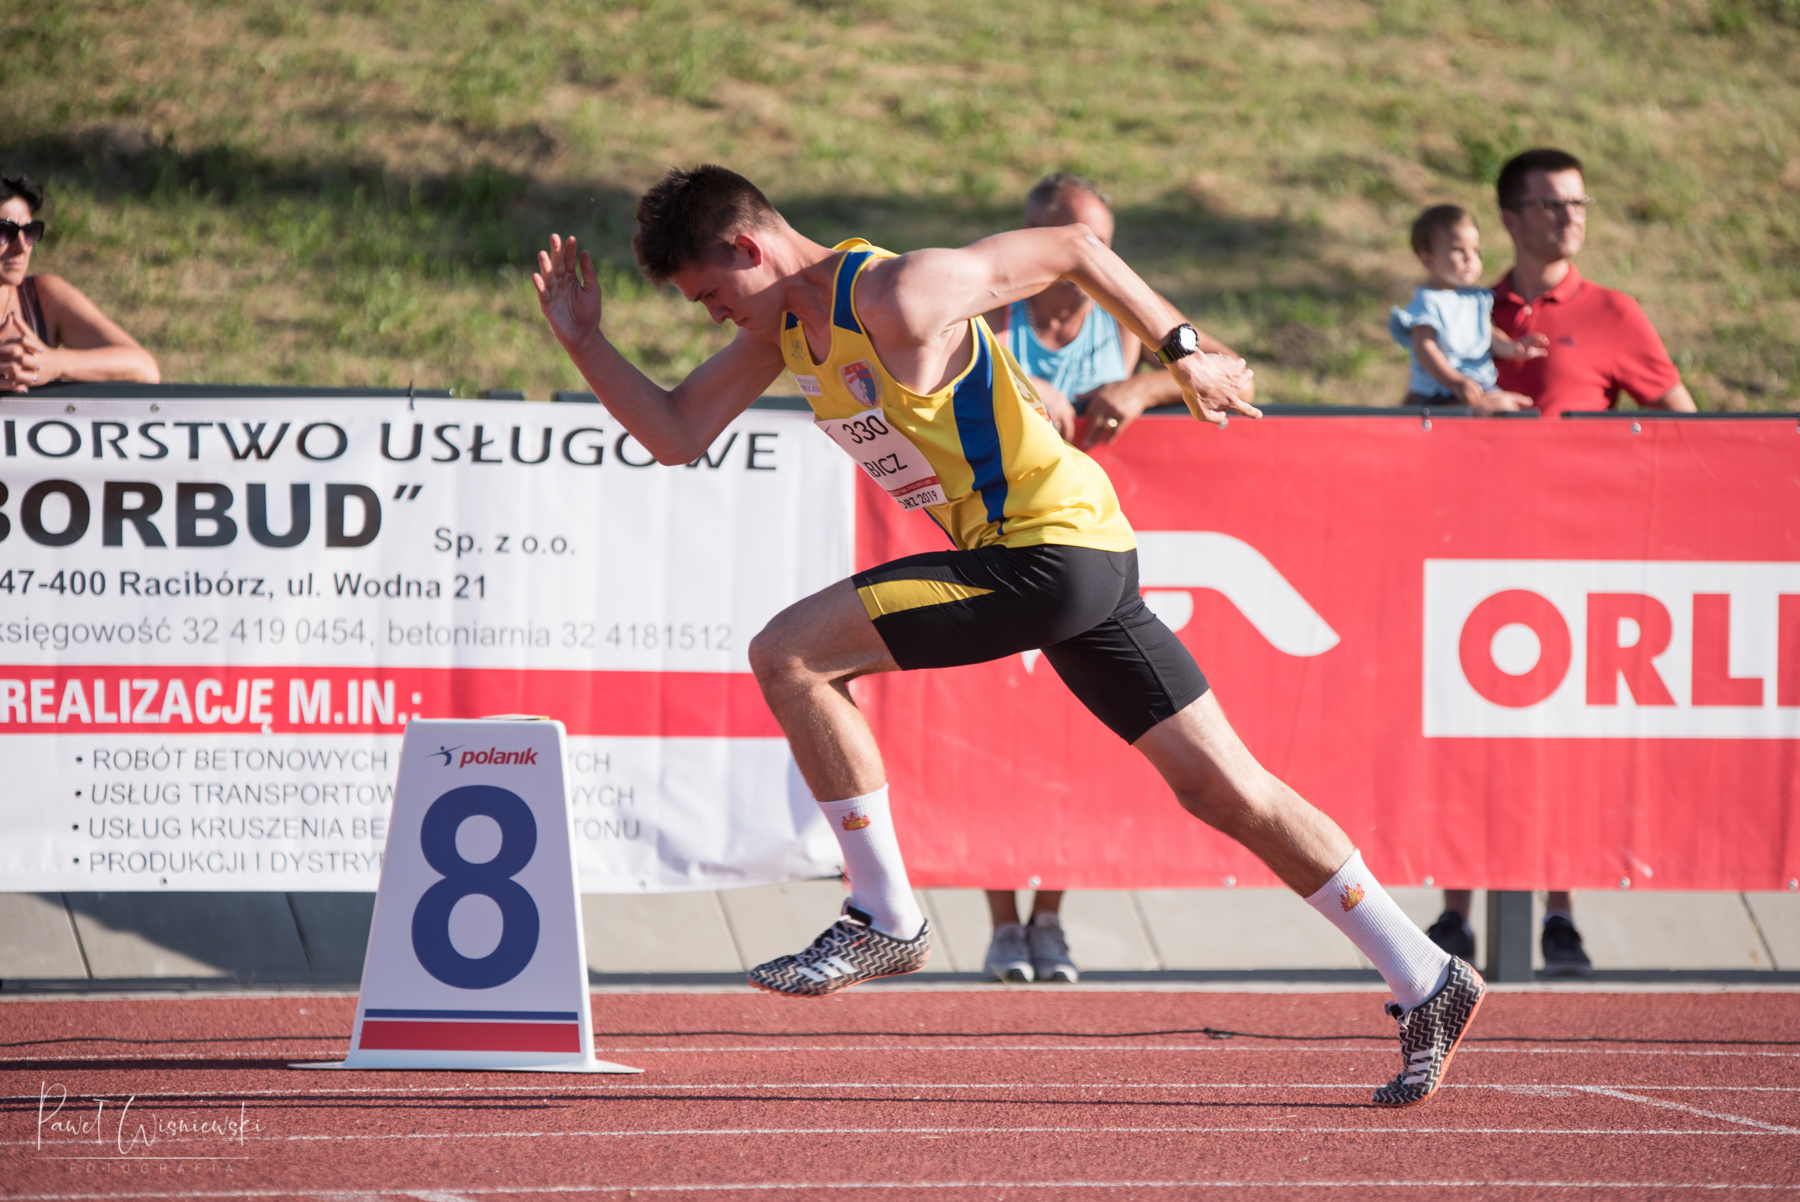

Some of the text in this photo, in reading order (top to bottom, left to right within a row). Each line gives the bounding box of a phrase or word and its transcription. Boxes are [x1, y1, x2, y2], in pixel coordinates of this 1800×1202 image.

[3, 420, 348, 462] IORSTWO
[842, 414, 889, 444] 330
[916, 489, 938, 504] 2019
[0, 478, 423, 549] ORBUD”
[433, 526, 576, 558] Sp. z o.o.
[0, 569, 486, 602] 47-400 Racibórz, ul. Wodna 21
[182, 617, 219, 645] 32
[230, 617, 286, 645] 419
[295, 617, 374, 651] 0454,
[387, 618, 551, 649] betoniarnia
[561, 621, 595, 649] 32
[605, 622, 733, 652] 4181512
[0, 678, 275, 736] REALIZACJĘ
[92, 744, 187, 772] ROBÓT
[194, 747, 388, 771] BETONOWYCH
[459, 747, 539, 769] polanik
[91, 783, 181, 805] USŁUG
[88, 817, 182, 839] USŁUG
[191, 817, 344, 840] KRUSZENIA
[352, 816, 391, 840] BE
[90, 851, 246, 874] PRODUKCJI
[411, 784, 540, 990] 8
